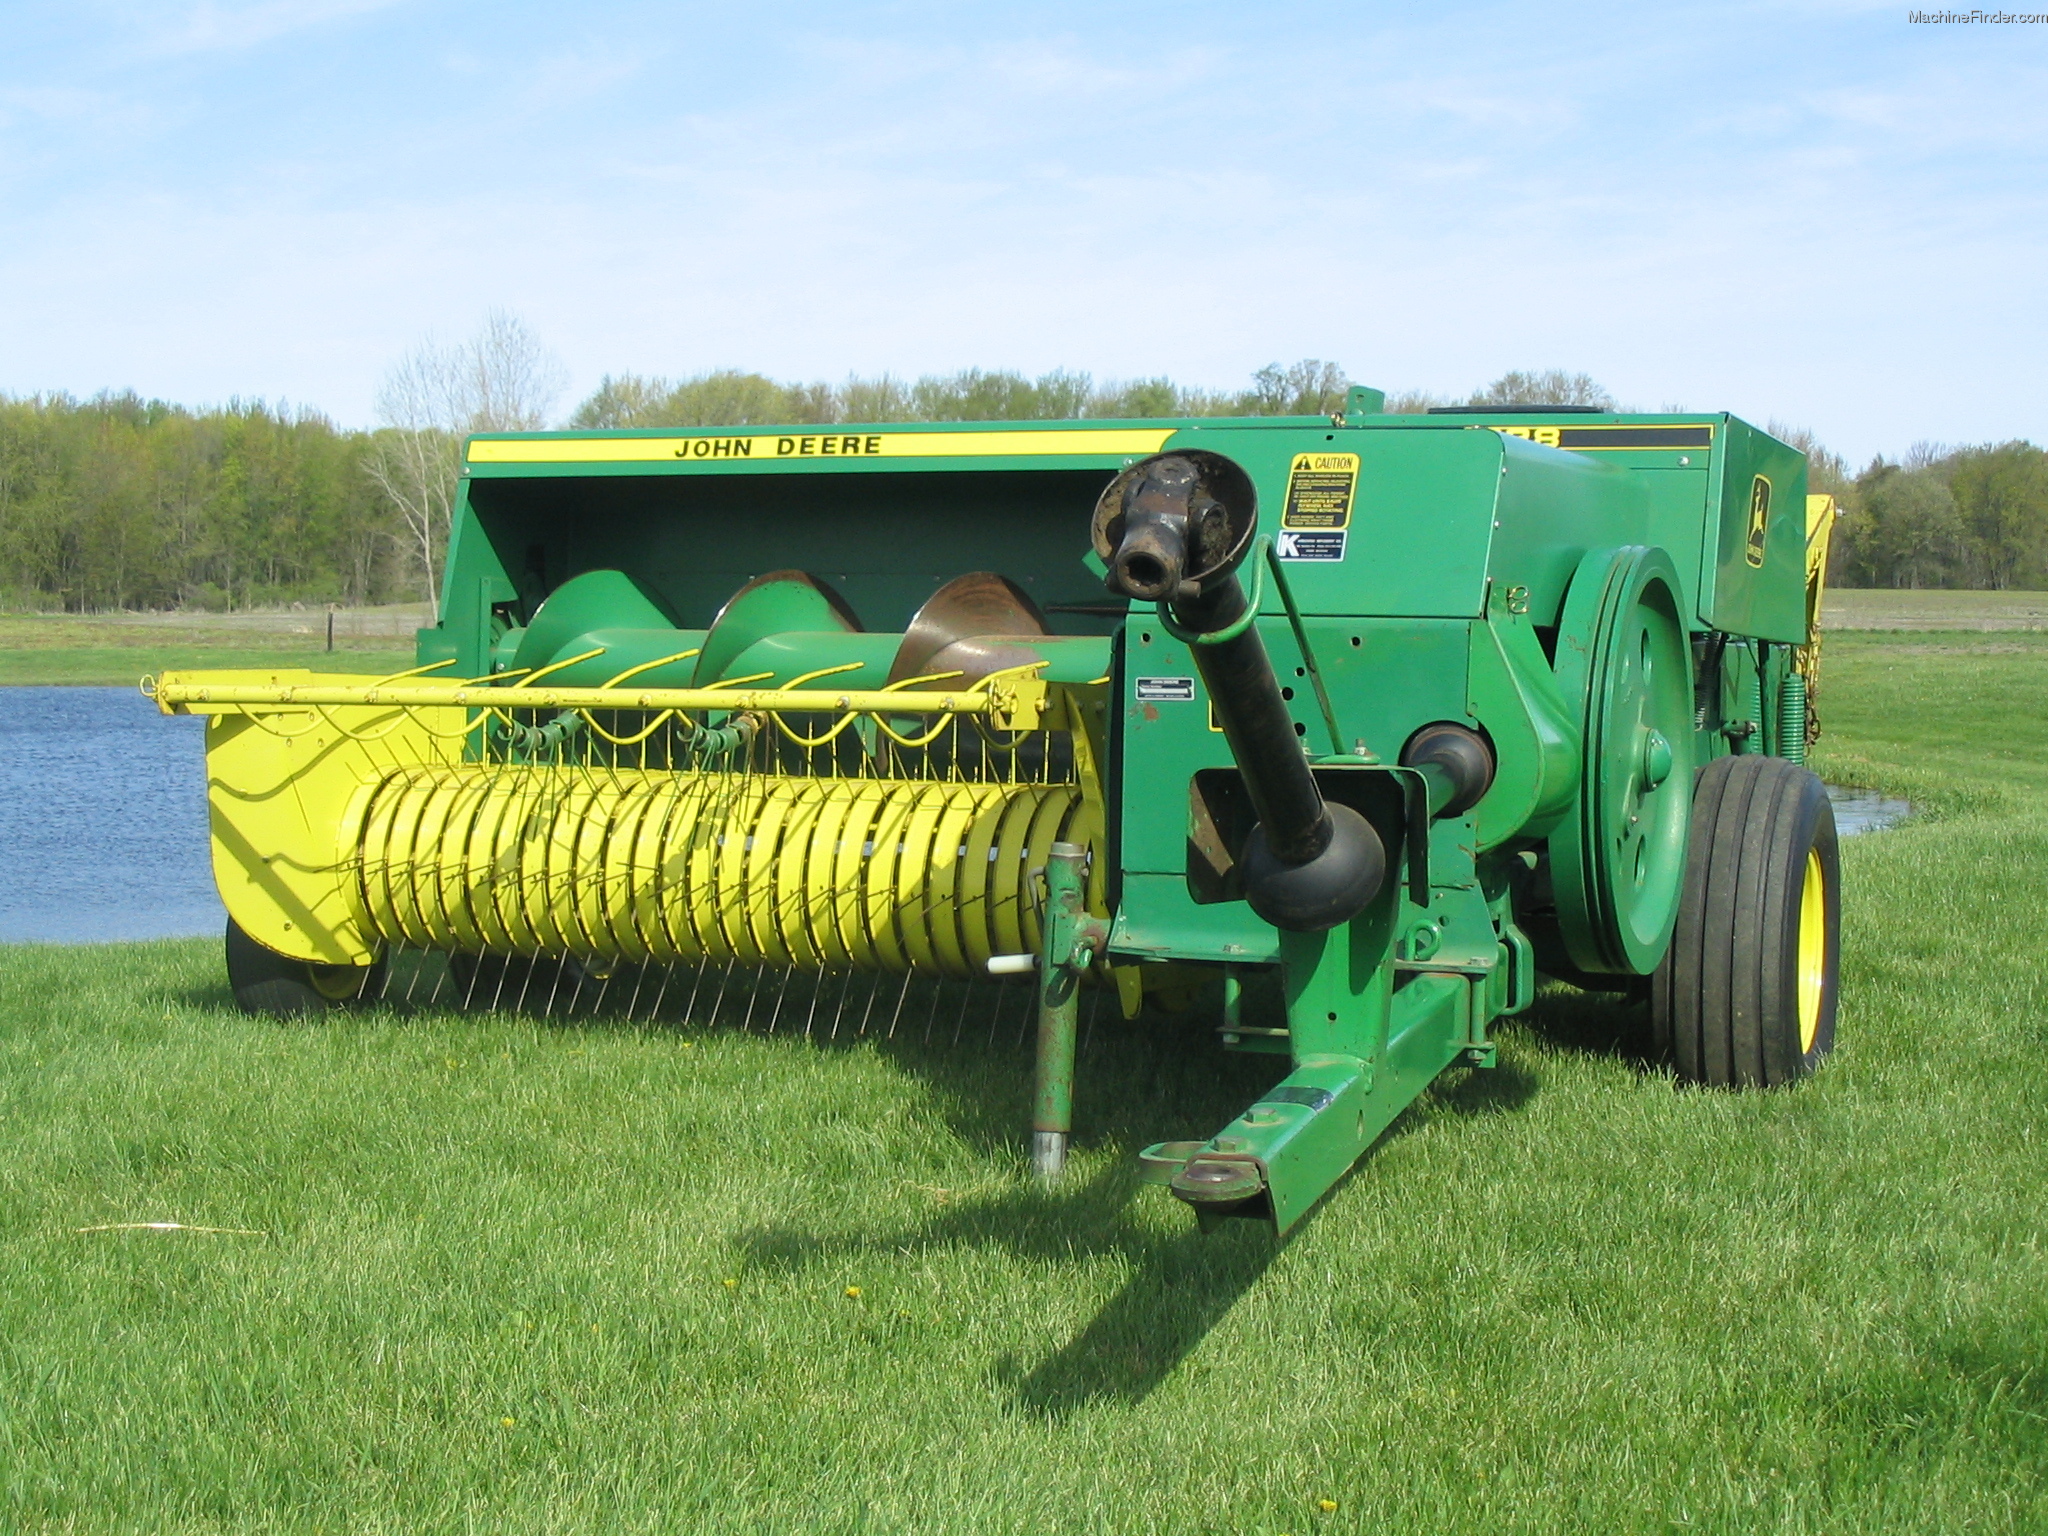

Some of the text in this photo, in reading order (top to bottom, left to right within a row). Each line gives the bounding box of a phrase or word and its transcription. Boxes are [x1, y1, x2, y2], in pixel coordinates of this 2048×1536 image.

[674, 435, 882, 458] JOHN DEERE
[1314, 456, 1353, 470] CAUTION
